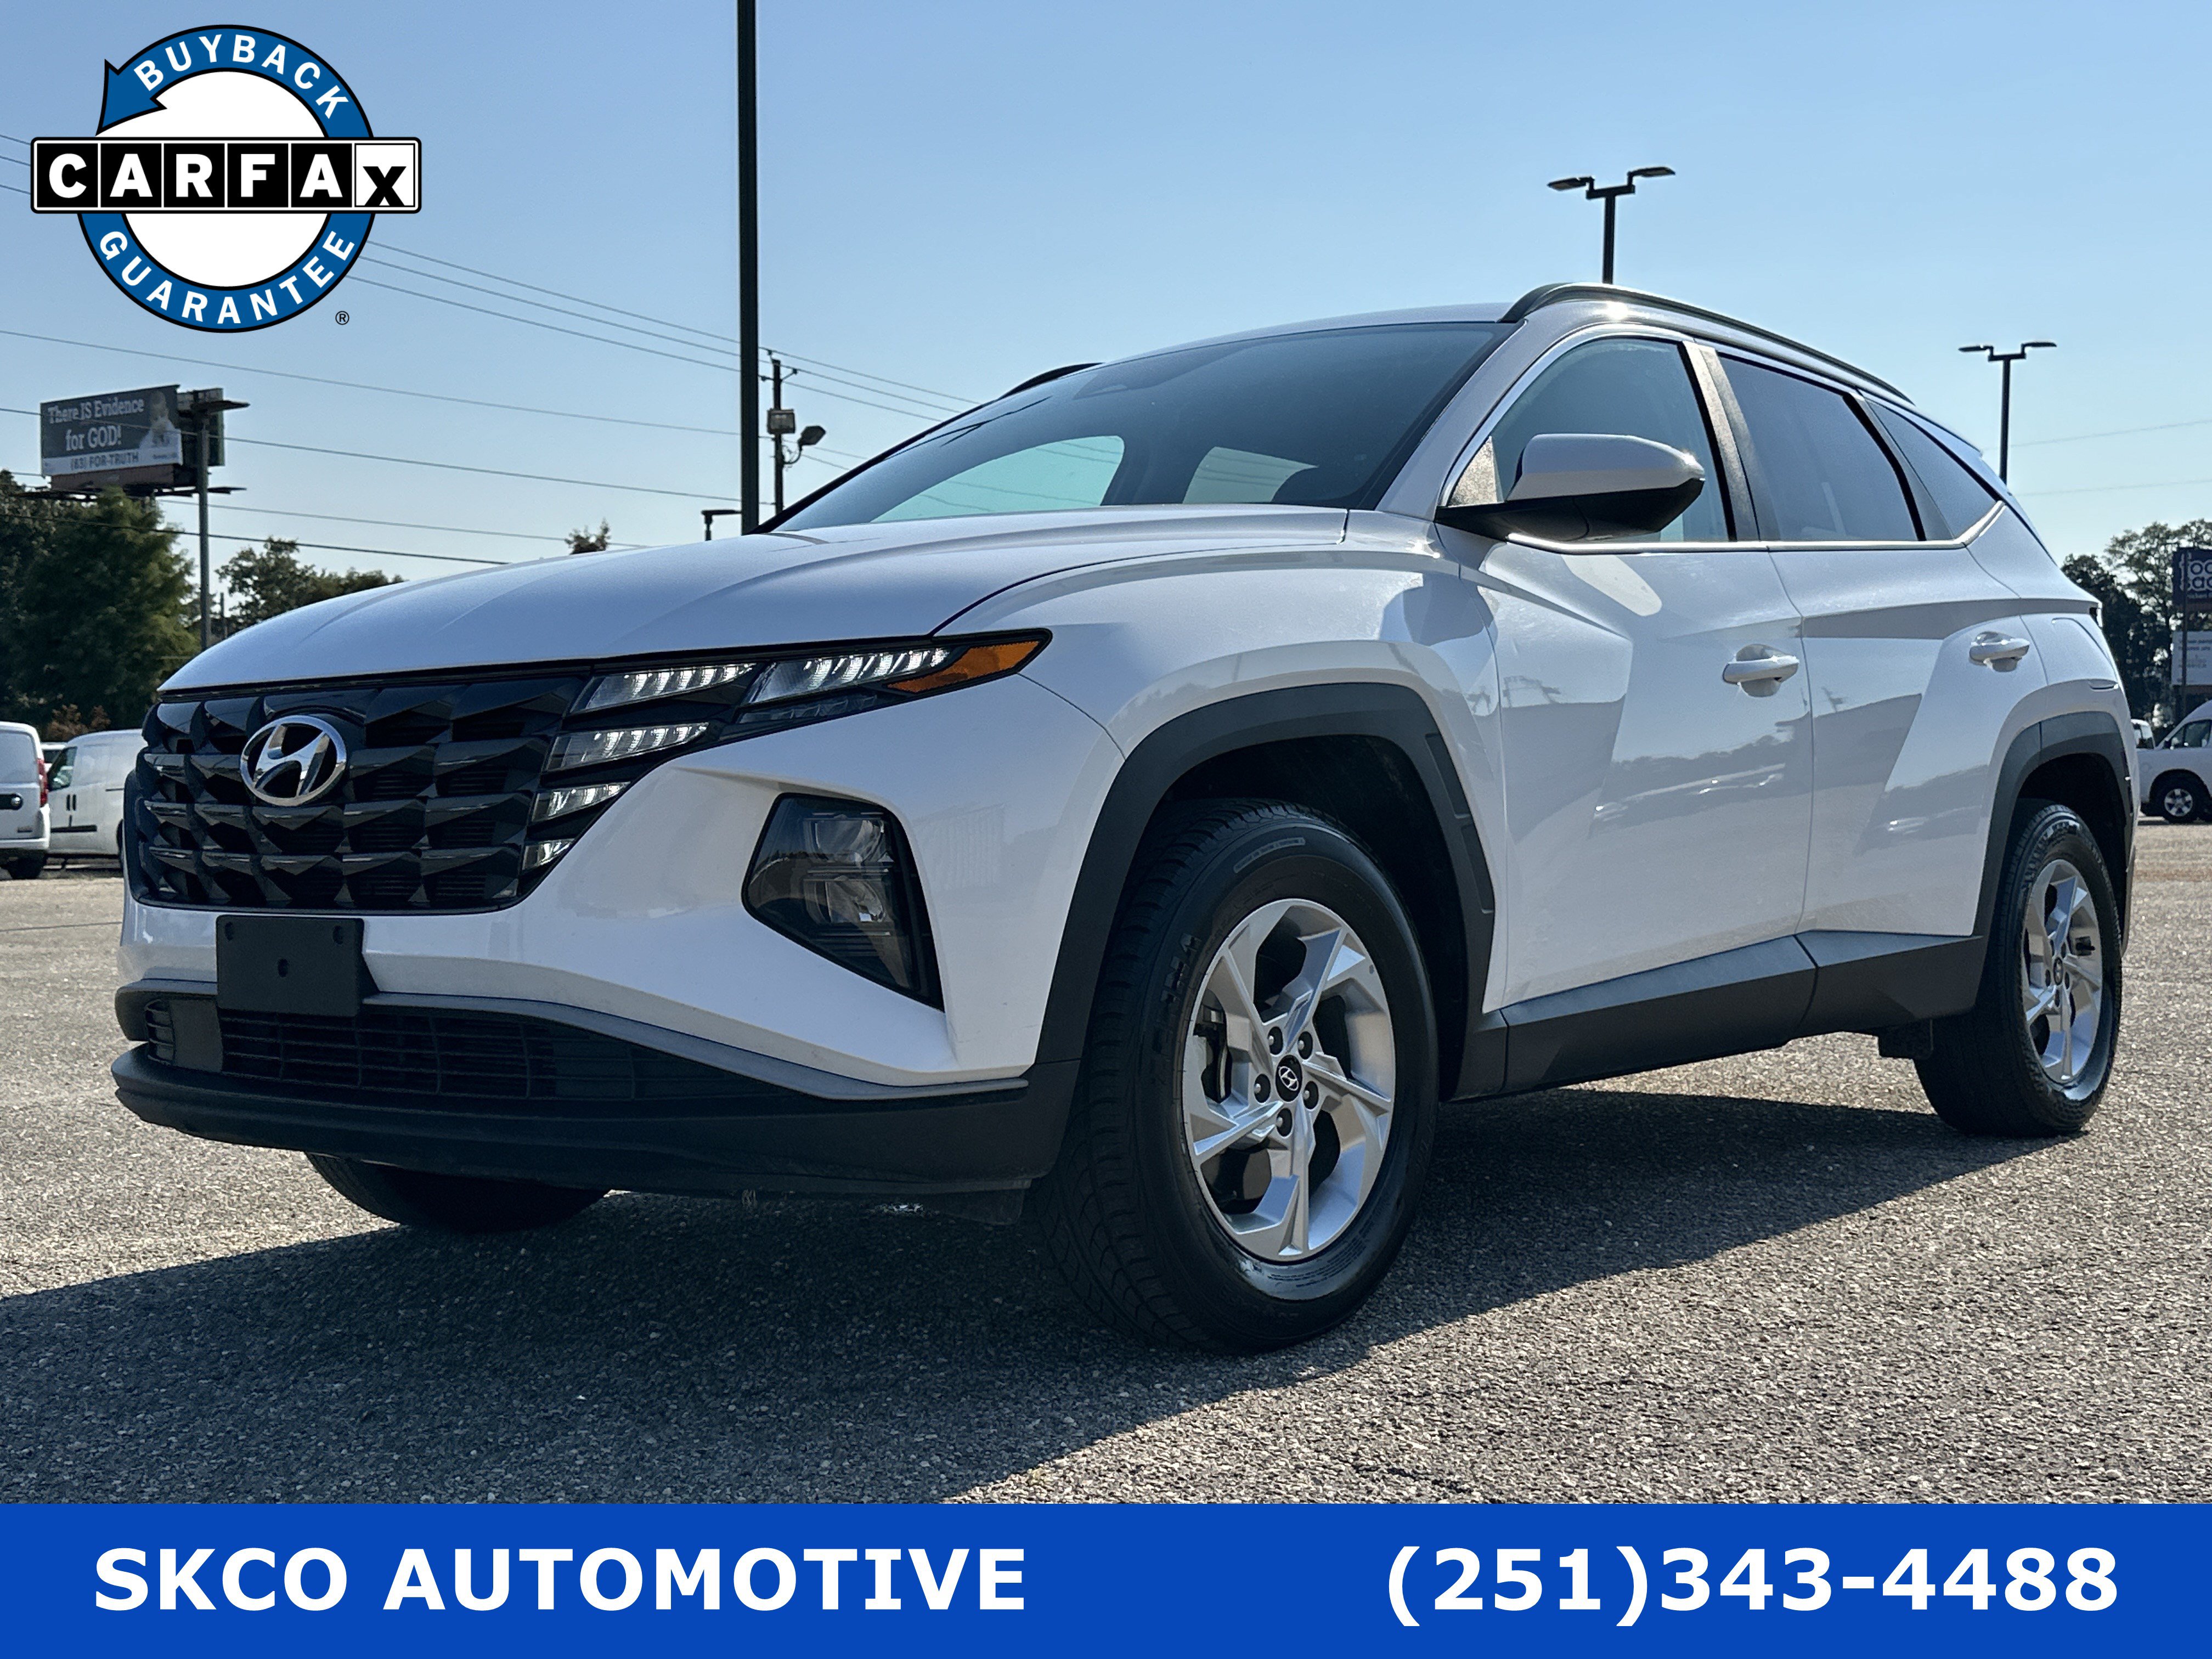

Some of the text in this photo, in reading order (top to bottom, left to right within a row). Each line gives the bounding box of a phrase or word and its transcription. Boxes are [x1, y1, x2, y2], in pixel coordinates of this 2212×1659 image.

[47, 405, 79, 424] There
[94, 397, 145, 417] Evidence
[65, 424, 122, 452] for GOD!
